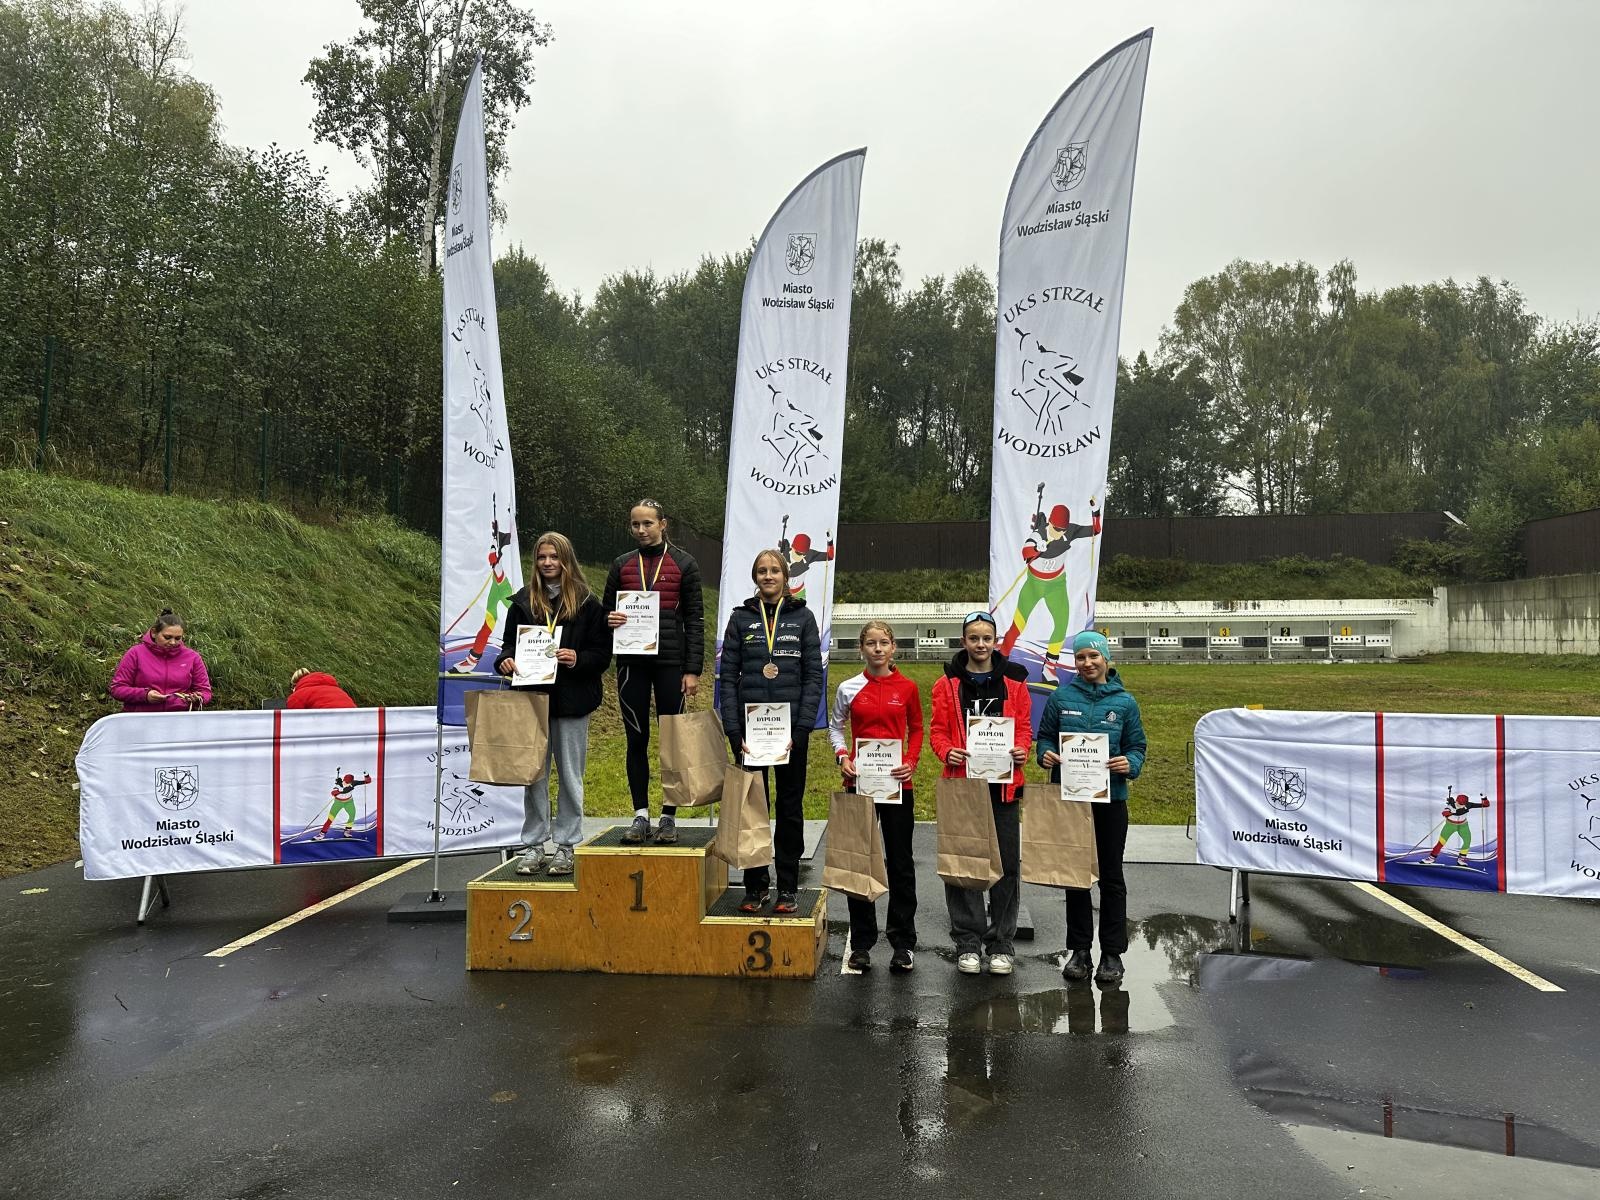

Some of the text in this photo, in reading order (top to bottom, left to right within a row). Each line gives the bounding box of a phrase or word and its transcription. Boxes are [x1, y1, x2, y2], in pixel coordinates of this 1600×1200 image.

[1046, 199, 1081, 215] Miasto
[1017, 208, 1109, 238] Wodzisław Śląski
[783, 283, 812, 294] Miasto
[762, 296, 835, 312] Wodzisław Śląski
[1003, 286, 1105, 324] UKS STRZAŁ
[755, 357, 832, 385] UKS STRZAŁ
[997, 425, 1102, 458] WODZISŁAW
[750, 467, 837, 495] WODZISŁAW
[1161, 628, 1166, 636] 4
[1222, 628, 1227, 636] 3
[1283, 627, 1288, 636] 2
[1568, 773, 1599, 790] UKS
[156, 819, 201, 834] Miasto
[1264, 818, 1308, 832] Miasto
[121, 827, 234, 851] Wodzisław Śląski
[1232, 830, 1342, 853] Wodzisław Śląski
[629, 870, 648, 912] 1
[507, 900, 534, 942] 2
[746, 931, 774, 971] 3
